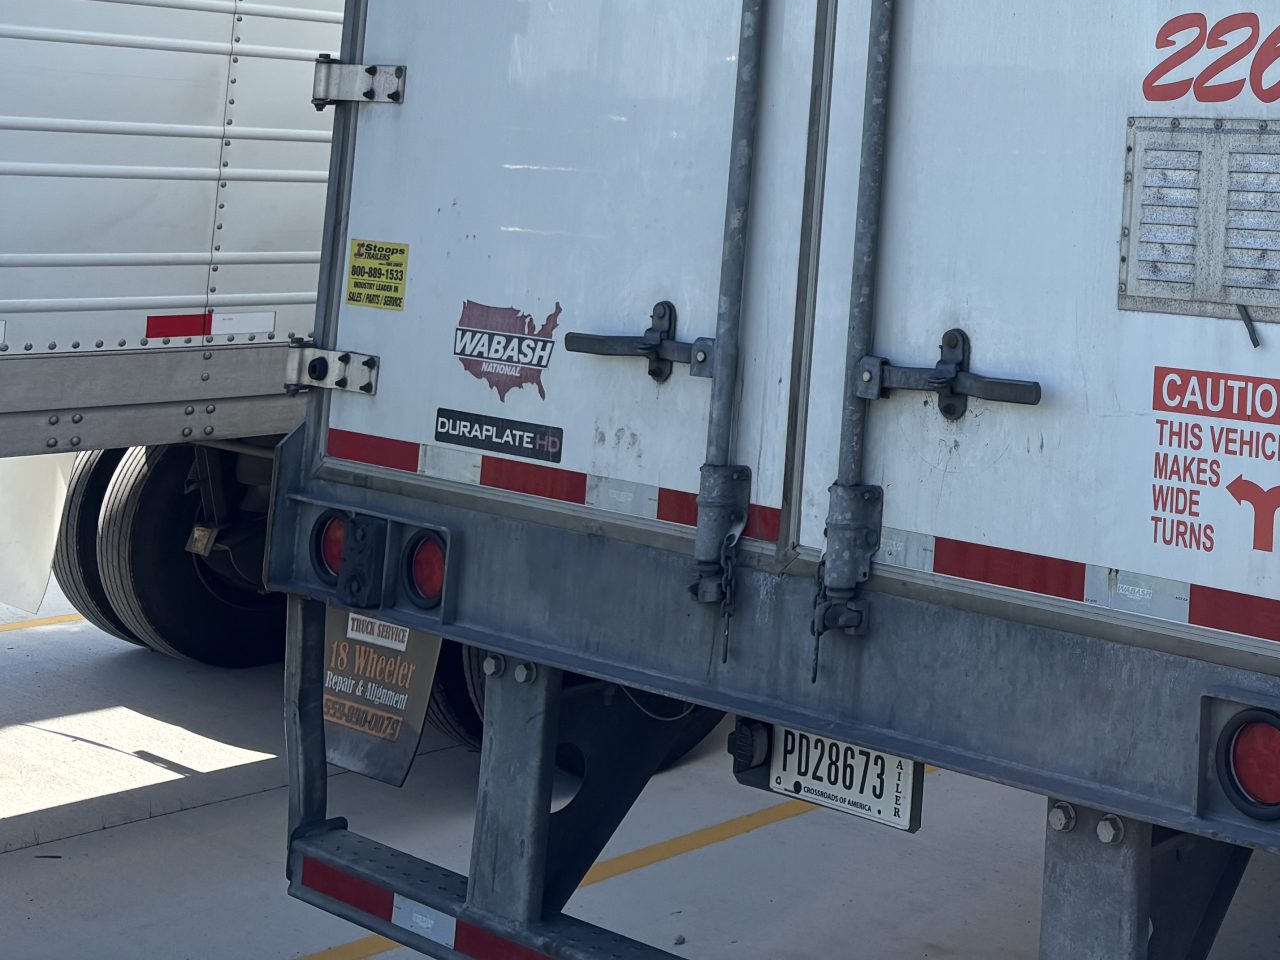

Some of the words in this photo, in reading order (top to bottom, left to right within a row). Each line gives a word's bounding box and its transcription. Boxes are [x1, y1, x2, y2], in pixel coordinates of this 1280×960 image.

[364, 252, 391, 261] TRAILERS
[365, 243, 406, 256] Stoops
[351, 265, 404, 282] 800-889-1533
[376, 283, 393, 292] LEADER
[347, 291, 363, 302] SALES
[365, 293, 380, 305] PARTS
[384, 296, 404, 307] SERVICE
[455, 330, 553, 366] WABASH
[481, 362, 521, 377] NATIONAL
[437, 417, 534, 449] DURAPLATE
[535, 435, 560, 453] HD
[1155, 419, 1204, 451] THIS
[1153, 452, 1221, 488] MAKES
[1152, 484, 1201, 517] WIDE
[1150, 516, 1215, 552] TURNS
[1117, 584, 1153, 599] WABASH
[350, 617, 376, 637] TRUCK
[376, 623, 408, 643] SERVICE
[329, 640, 350, 671] 18
[354, 644, 417, 689] Wheeler
[325, 670, 355, 695] Repair
[355, 679, 364, 696] &
[364, 681, 409, 710] Alignment
[782, 728, 886, 800] PD28673
[803, 786, 839, 802] CROSSROADS
[838, 796, 847, 807] OF
[847, 798, 872, 813] AMERICA
